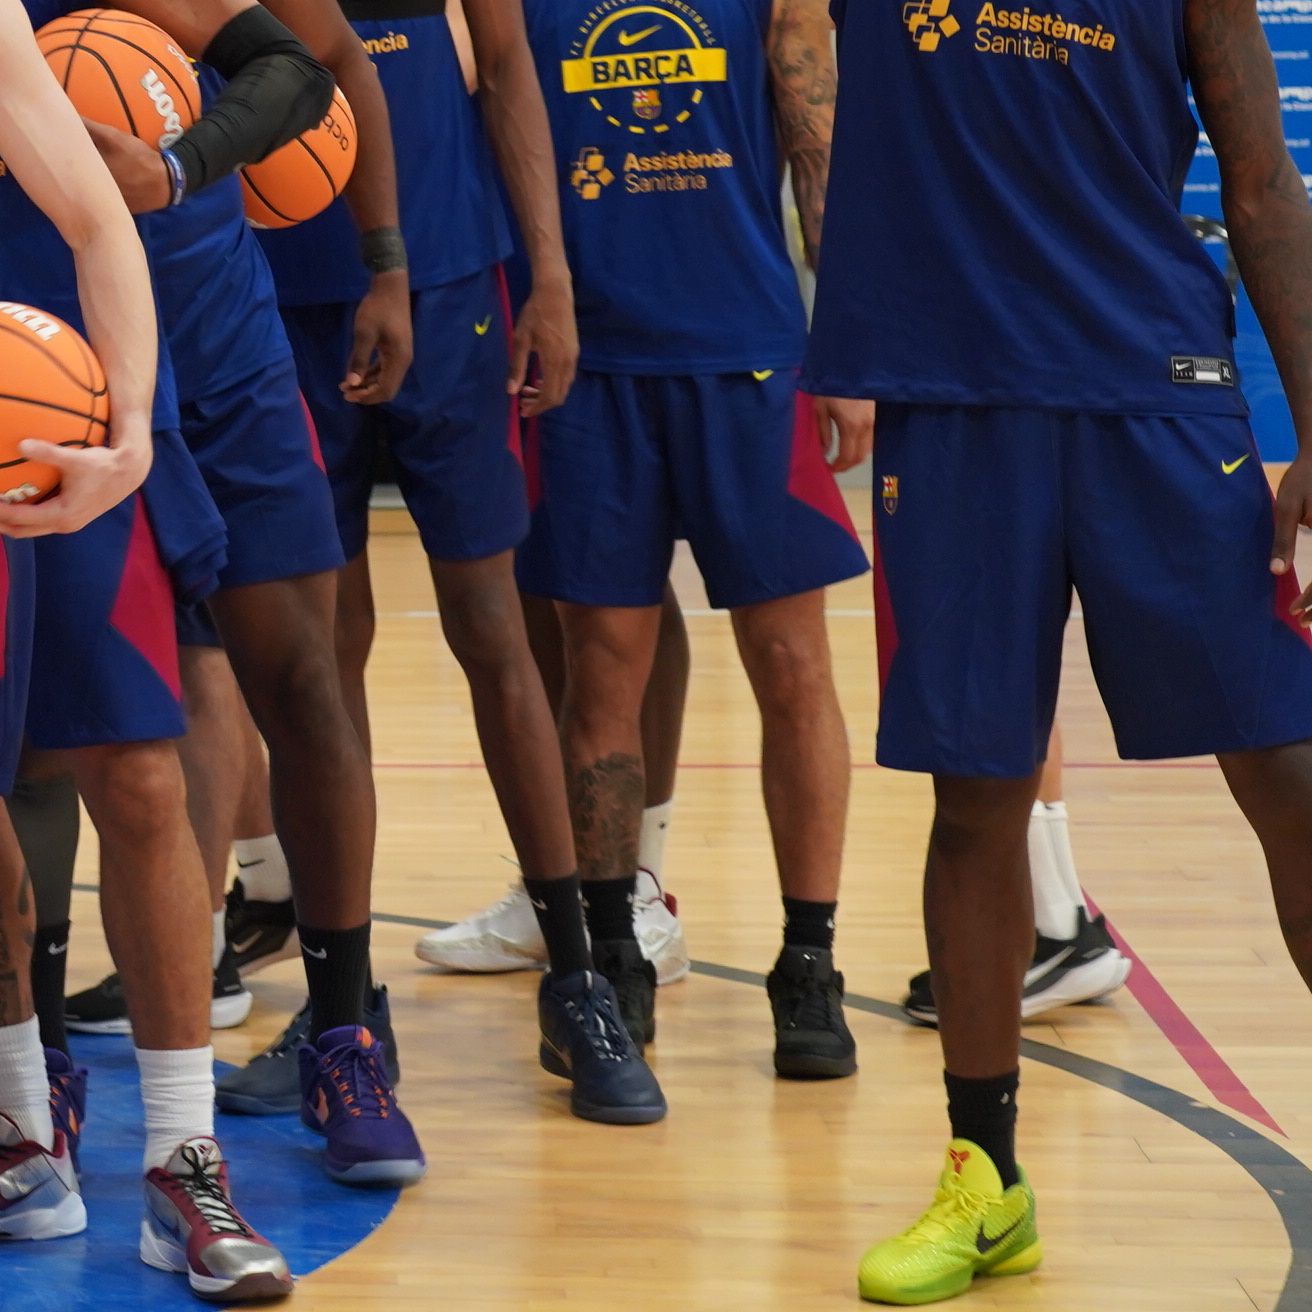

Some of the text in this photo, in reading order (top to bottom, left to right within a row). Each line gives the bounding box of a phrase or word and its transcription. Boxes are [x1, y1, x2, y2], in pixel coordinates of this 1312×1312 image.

[975, 1, 1117, 52] Assistència
[974, 28, 1069, 66] Sanitària
[591, 54, 695, 86] BARÇA
